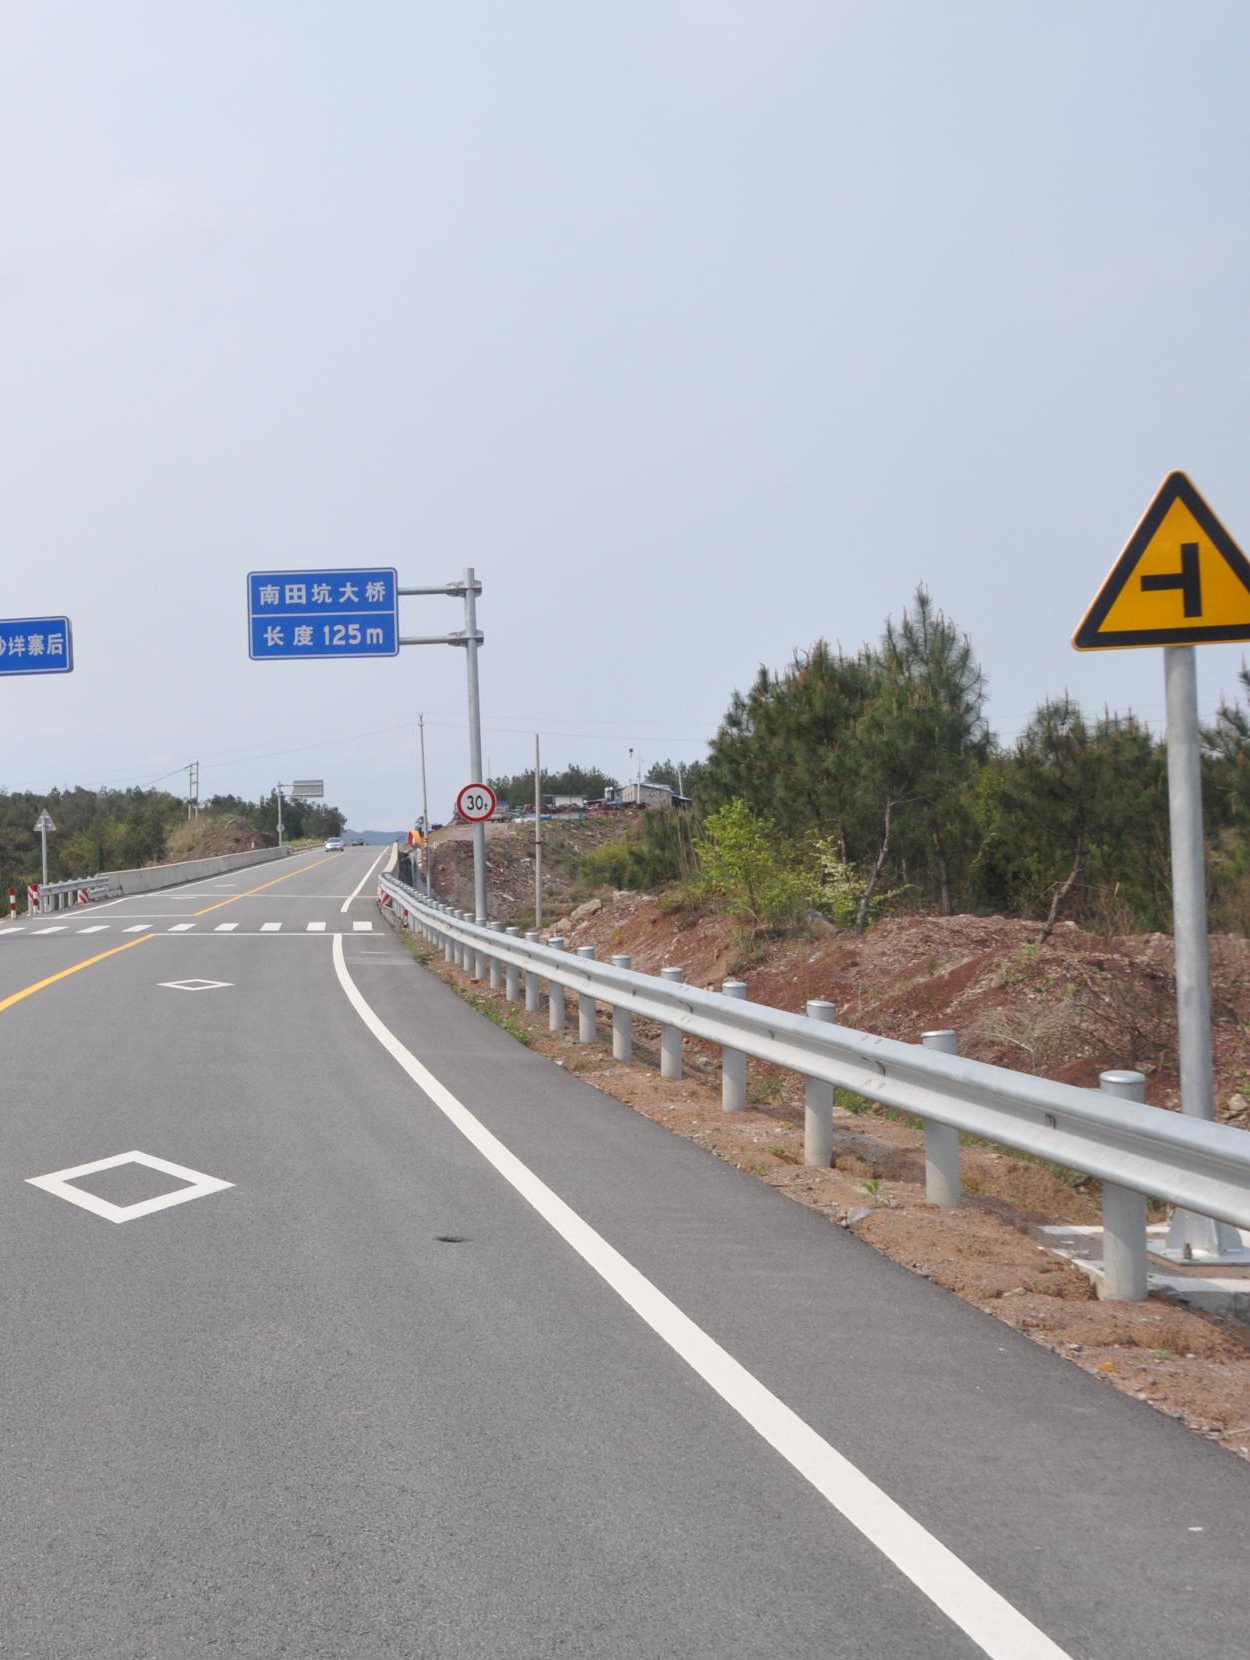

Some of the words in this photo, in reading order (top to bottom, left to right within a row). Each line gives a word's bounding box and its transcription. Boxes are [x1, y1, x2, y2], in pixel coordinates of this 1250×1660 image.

[258, 581, 386, 605] 南田坑大桥
